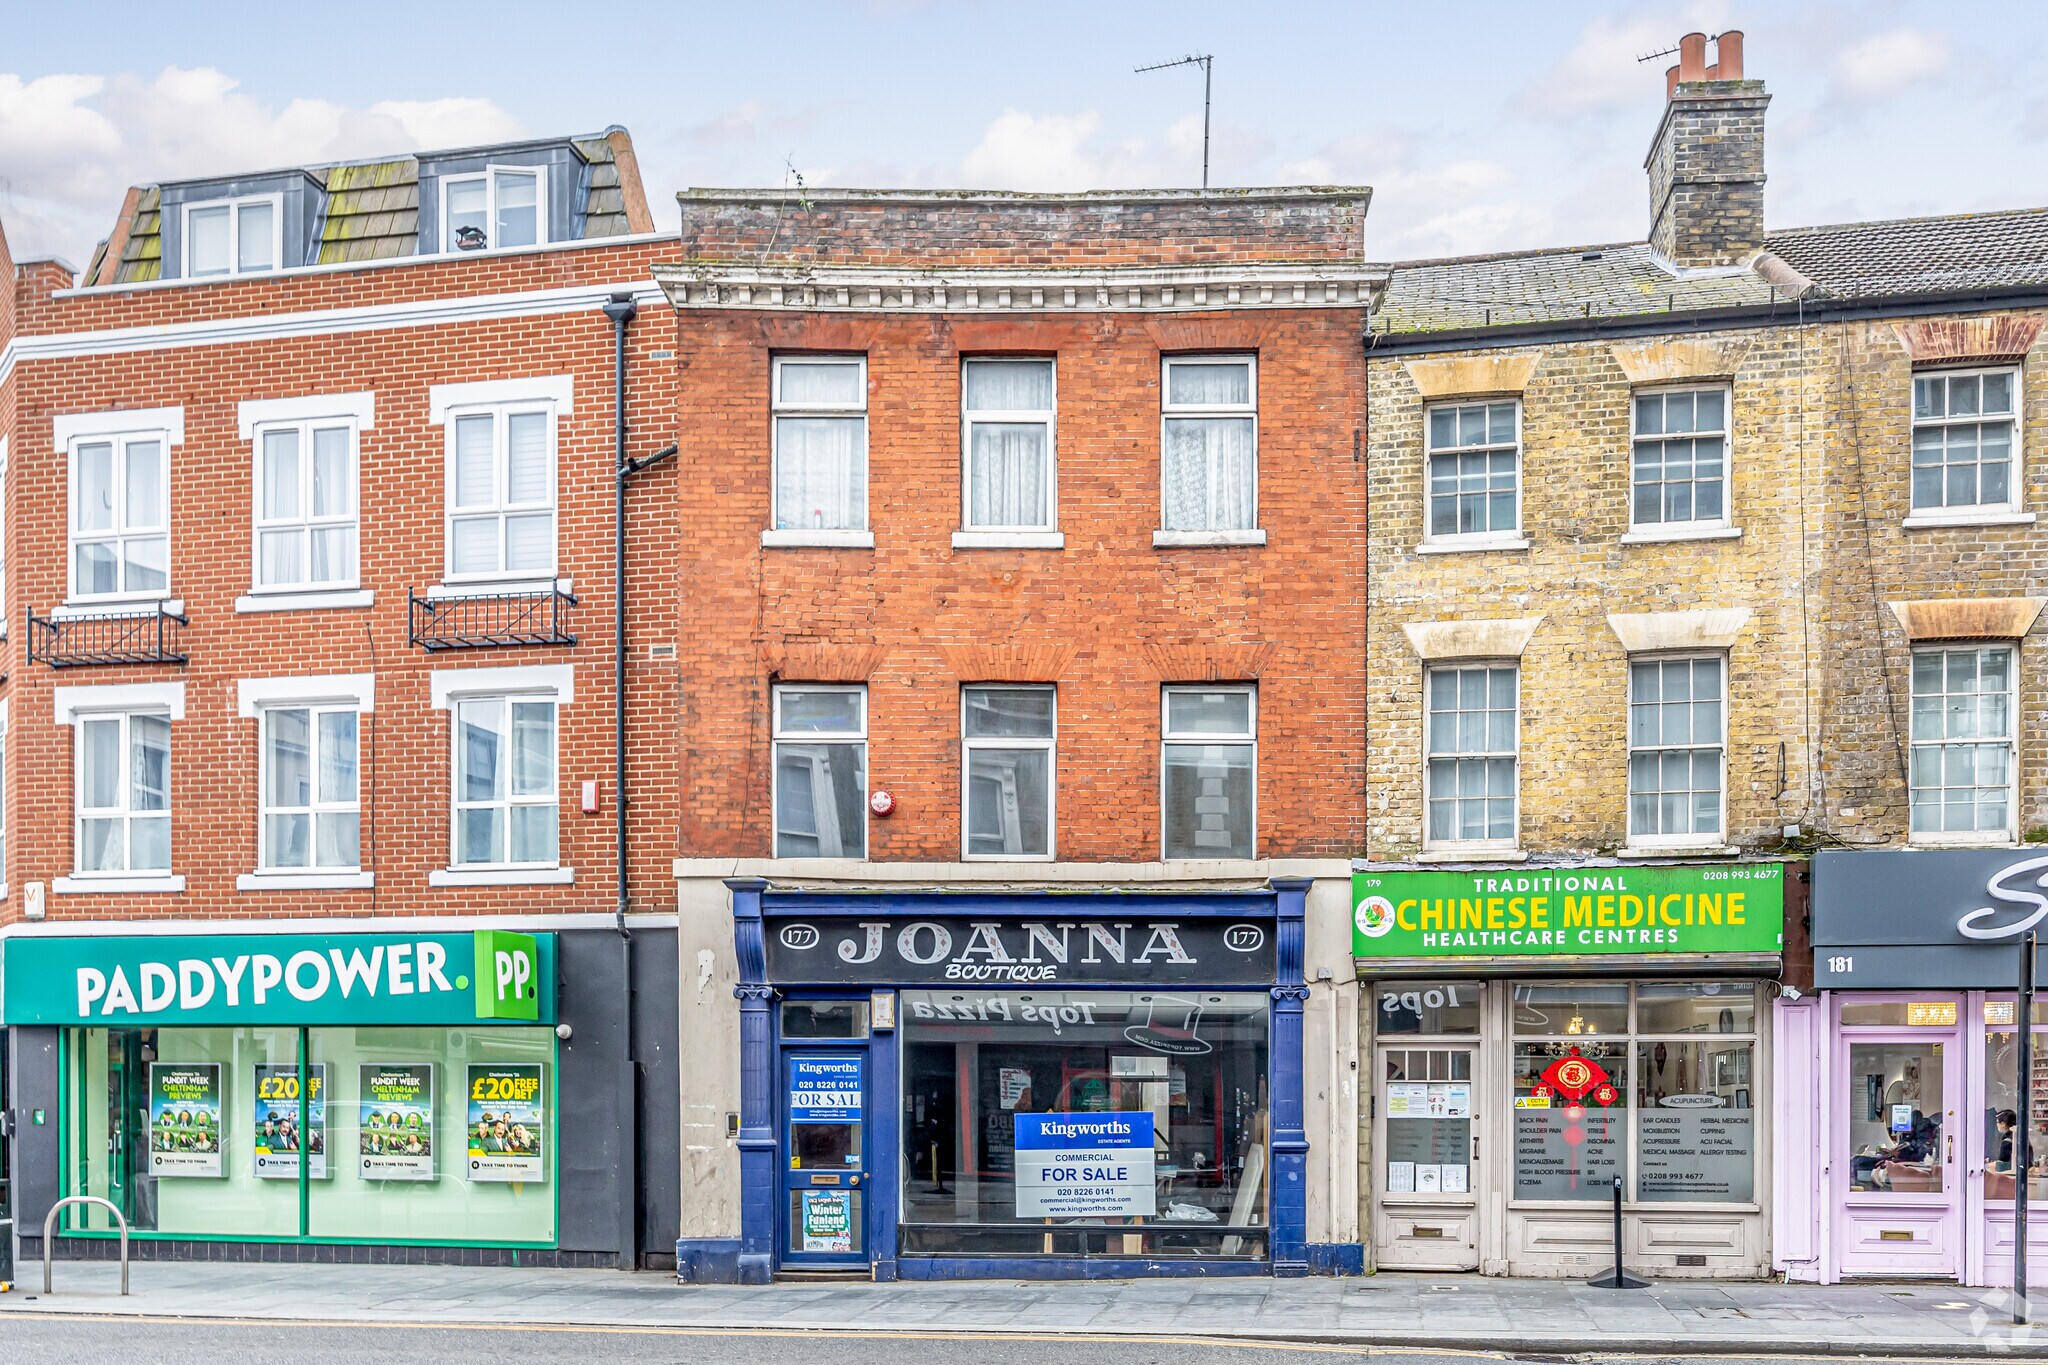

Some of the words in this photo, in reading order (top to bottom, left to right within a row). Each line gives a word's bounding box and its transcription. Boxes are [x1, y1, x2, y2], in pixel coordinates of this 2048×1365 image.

[1703, 872, 1729, 881] 0208
[1732, 871, 1751, 880] 993
[1754, 869, 1779, 879] 4677
[1366, 879, 1381, 888] 179
[1474, 876, 1627, 893] TRADITIONAL
[1396, 897, 1548, 930] CHINESE
[1564, 892, 1746, 928] MEDICINE
[786, 929, 812, 944] 177
[837, 922, 1197, 964] JOANNA
[1232, 931, 1259, 945] 177
[1423, 930, 1566, 947] HEALTHCARE
[1578, 929, 1679, 945] CENTRES
[1828, 956, 1853, 973] 181
[944, 964, 1058, 982] BOUTIQUE
[799, 1063, 857, 1074] Kingworths
[259, 1077, 299, 1098] £20
[309, 1078, 321, 1088] EE
[472, 1078, 515, 1100] £20
[514, 1078, 538, 1089] FREE
[514, 1089, 533, 1100] BET
[827, 1093, 861, 1105] SAL
[1040, 1121, 1130, 1138] Kingworths
[1055, 1154, 1114, 1162] COMMERCIAL
[1042, 1168, 1077, 1181] FOR
[1083, 1167, 1127, 1180] SALE
[810, 1204, 843, 1216] Winter
[809, 1215, 845, 1225] Funland
